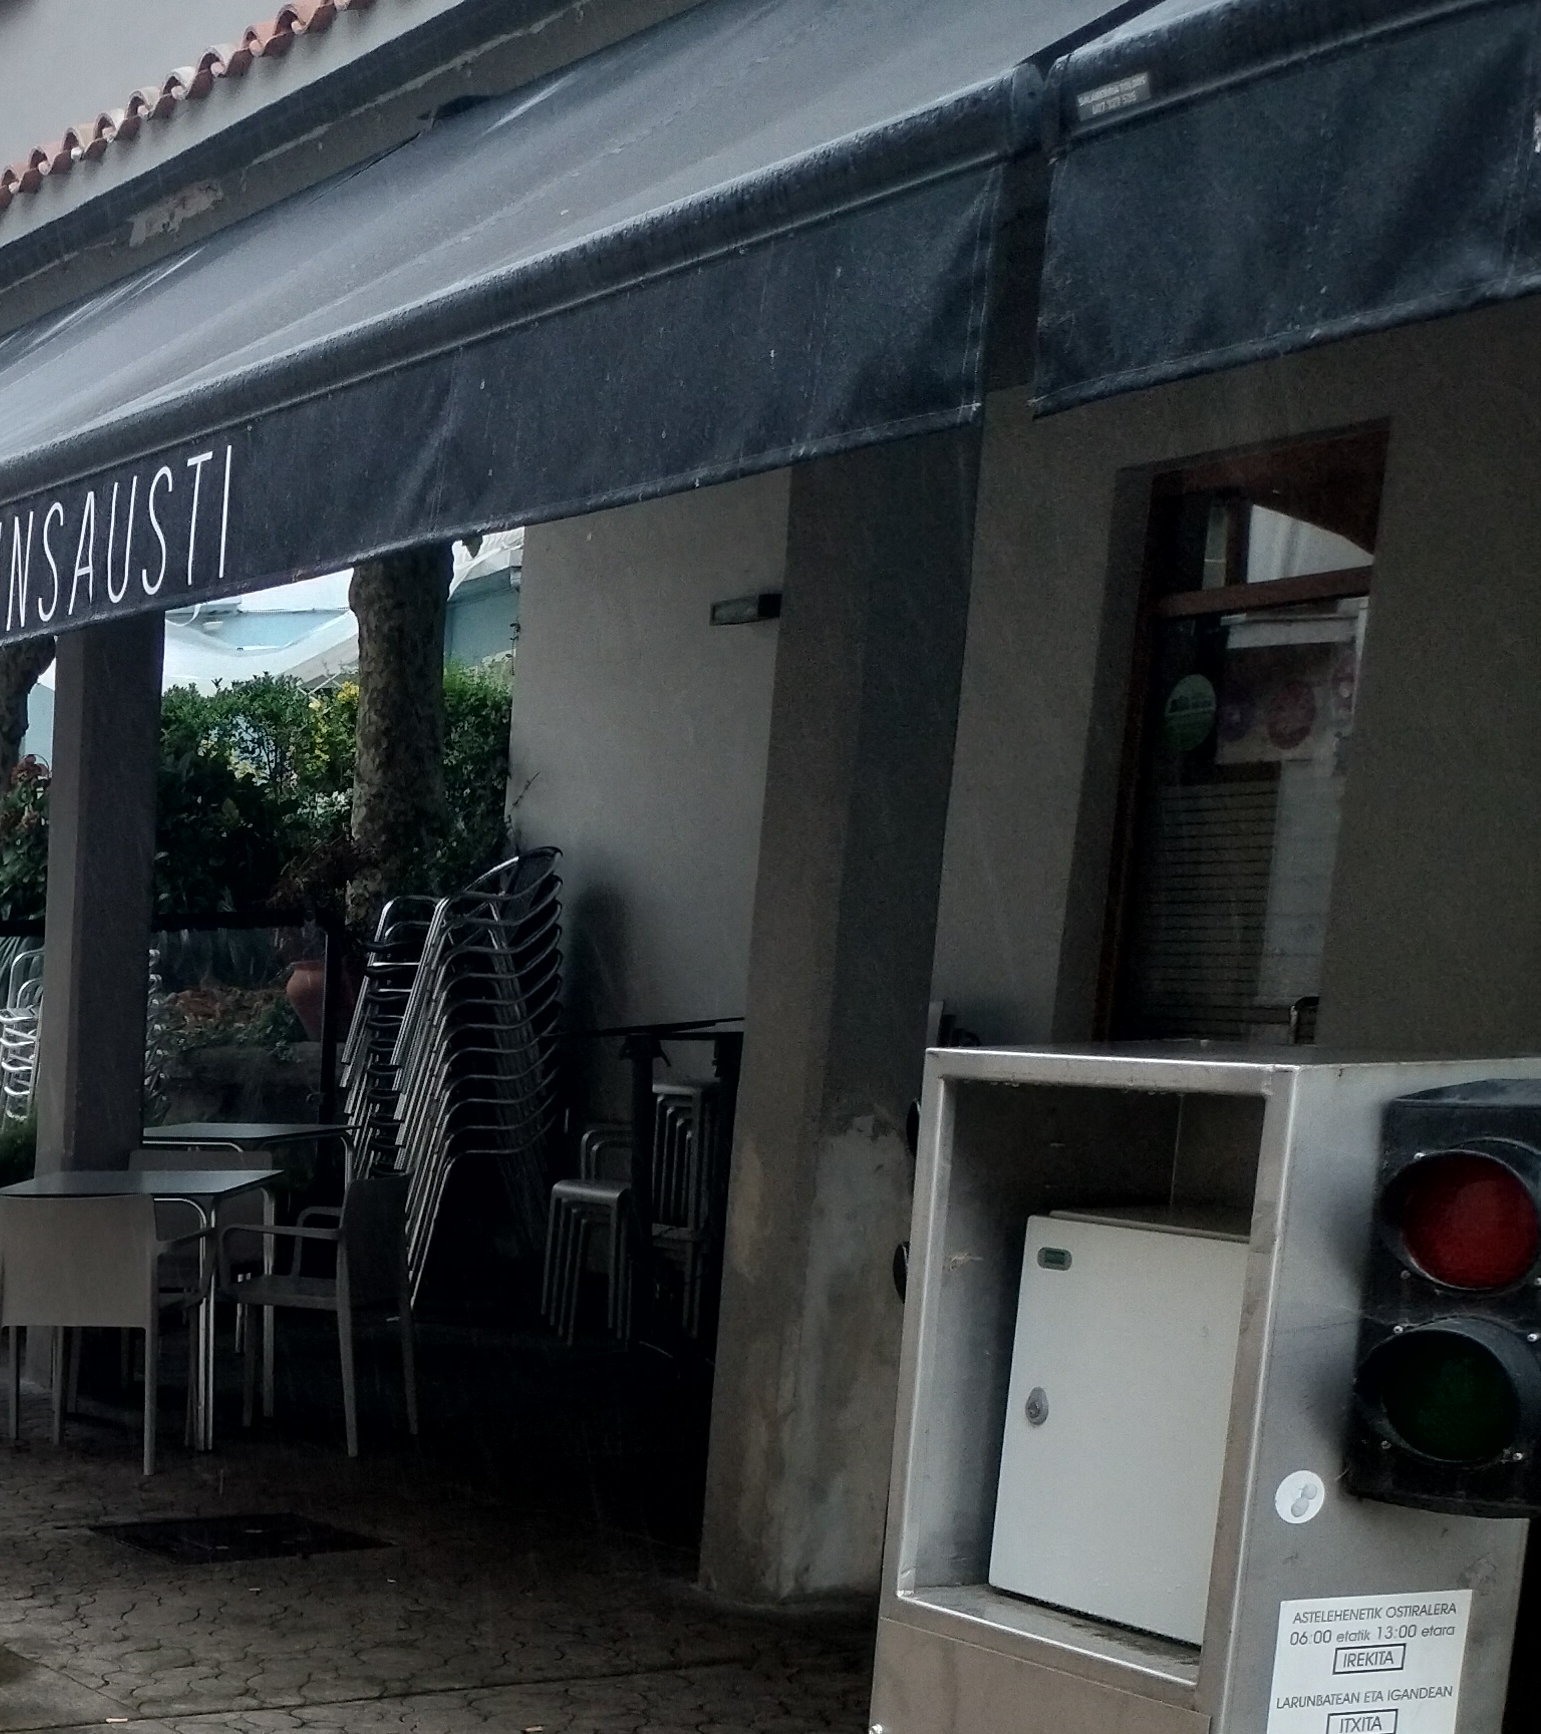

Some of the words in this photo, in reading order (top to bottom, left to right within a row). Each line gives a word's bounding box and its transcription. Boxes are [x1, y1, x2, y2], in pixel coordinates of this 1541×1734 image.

[1292, 1606, 1383, 1625] ASTELEHENETIK
[1386, 1602, 1457, 1618] OSTIRALERA
[1289, 1629, 1332, 1646] 06:00
[1336, 1629, 1371, 1643] etatik
[1377, 1624, 1417, 1640] 13:00
[1421, 1624, 1456, 1638] etara
[1342, 1651, 1394, 1668] IREKITA
[1276, 1691, 1360, 1710] LARUNBATEAN
[1363, 1690, 1384, 1703] ETA
[1387, 1685, 1453, 1701] IGANDEAN
[1339, 1716, 1383, 1734] ITXITA
